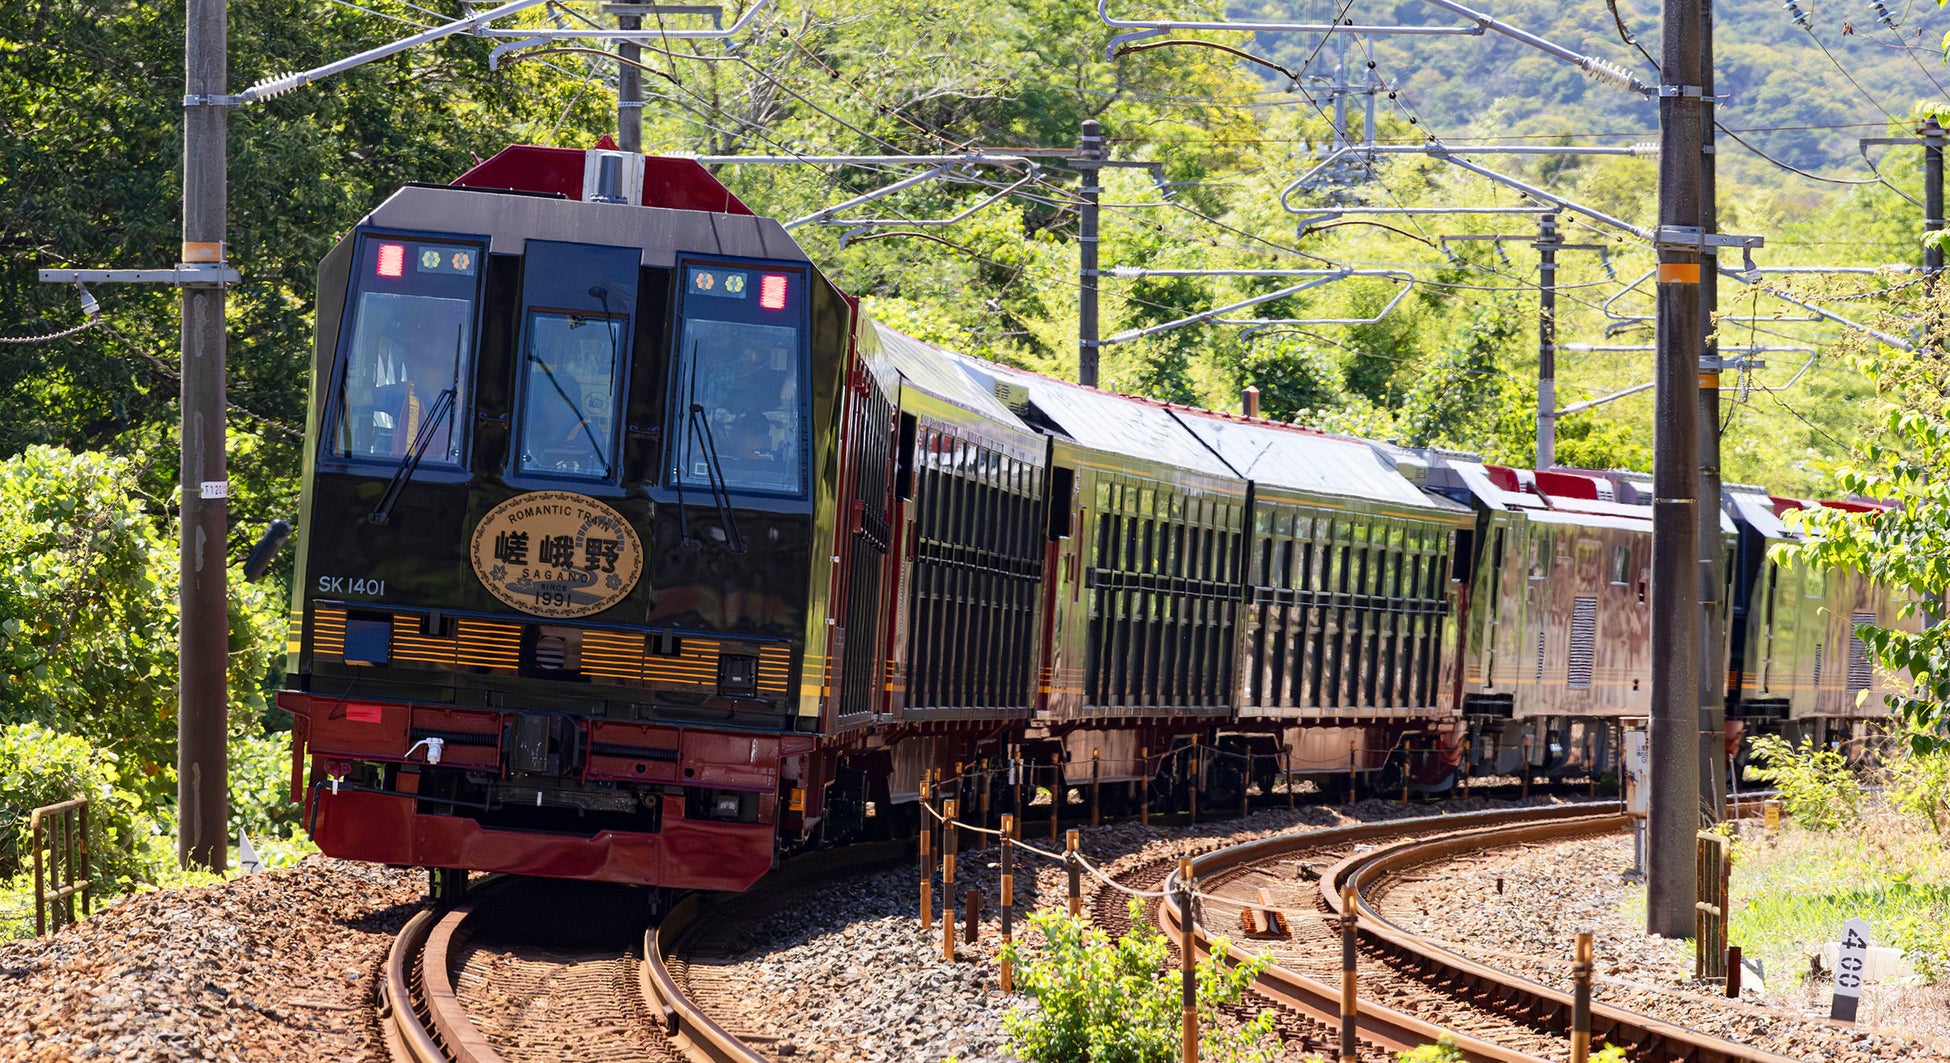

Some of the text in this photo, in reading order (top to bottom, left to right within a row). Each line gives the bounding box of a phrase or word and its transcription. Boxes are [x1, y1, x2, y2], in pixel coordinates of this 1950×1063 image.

[508, 505, 611, 532] ROMANTIC TRAIN
[494, 530, 620, 573] 嵯峨野
[318, 575, 385, 596] SK 1401
[522, 568, 588, 584] SAGANO
[541, 583, 568, 592] SINCE
[535, 591, 571, 608] 1991
[1838, 928, 1867, 988] 400
